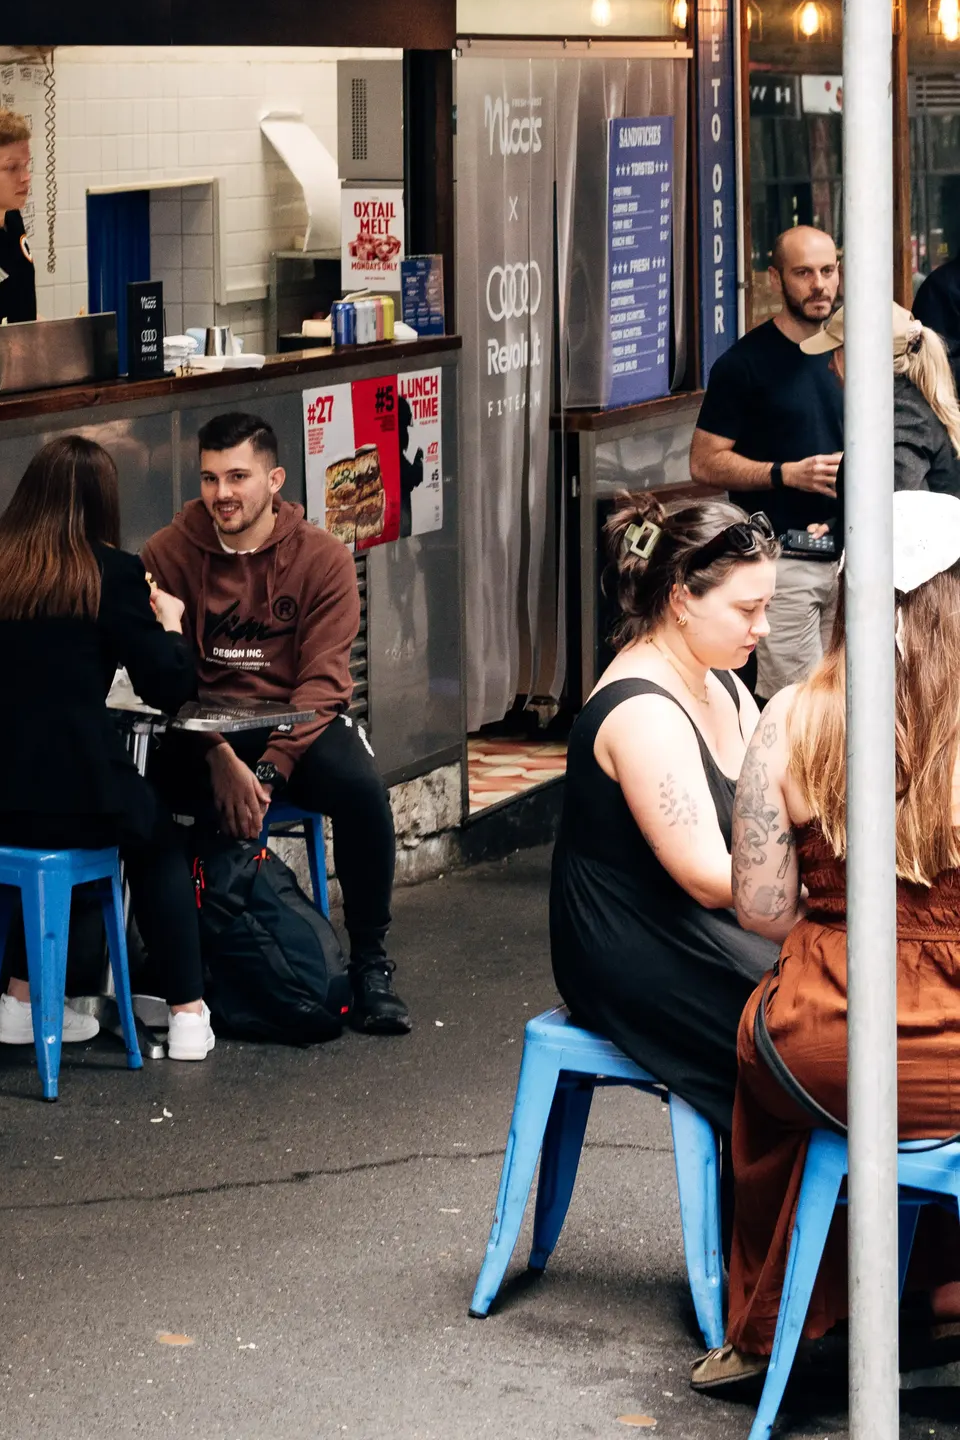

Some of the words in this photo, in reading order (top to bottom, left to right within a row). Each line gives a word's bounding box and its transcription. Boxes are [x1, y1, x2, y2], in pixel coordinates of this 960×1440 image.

[711, 78, 721, 143] TO
[619, 125, 661, 148] SANDWICHES
[353, 201, 396, 218] OXTAIL
[360, 218, 390, 235] MELT
[712, 162, 725, 335] ORDER
[351, 261, 381, 271] MONDAYS
[382, 262, 397, 271] ONLY
[630, 257, 650, 274] FRESH
[401, 375, 438, 399] LUNCH
[307, 395, 334, 425] #27
[375, 385, 394, 414] #5
[412, 397, 438, 420] TIME
[212, 647, 245, 659] DESIGN
